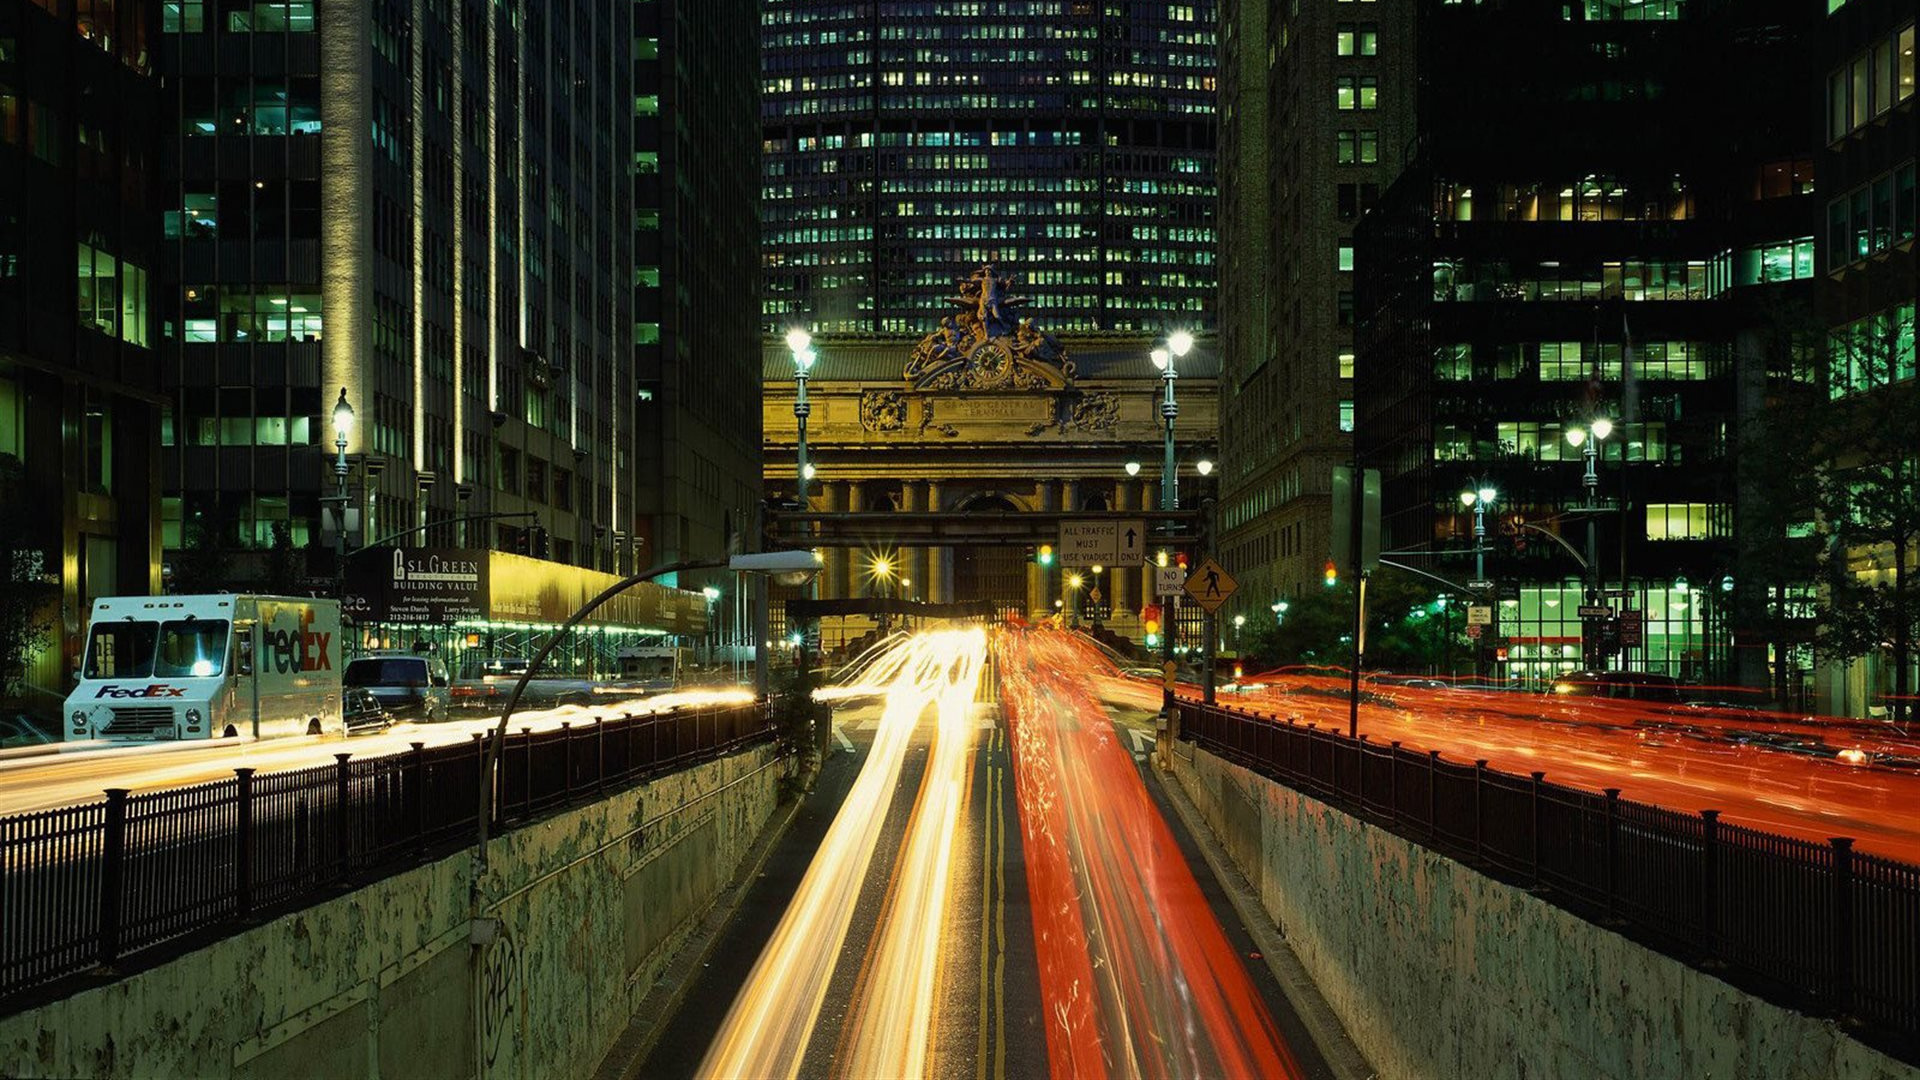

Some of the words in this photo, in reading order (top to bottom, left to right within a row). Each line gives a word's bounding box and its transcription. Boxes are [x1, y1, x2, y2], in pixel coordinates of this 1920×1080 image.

[1063, 527, 1080, 536] ALL
[1081, 526, 1115, 535] TRAFFIC
[1076, 540, 1099, 548] MUST
[1063, 553, 1079, 561] USE
[1082, 552, 1113, 561] VIADUCT
[407, 559, 425, 572] SL
[1164, 571, 1177, 580] NO
[393, 581, 443, 591] BUILDING
[447, 582, 478, 591] VALUE
[402, 595, 411, 603] for
[411, 595, 429, 604] leasing
[430, 596, 459, 604] information
[444, 606, 460, 614] Larry
[262, 608, 332, 675] FedEx
[95, 684, 188, 698] FedEx
